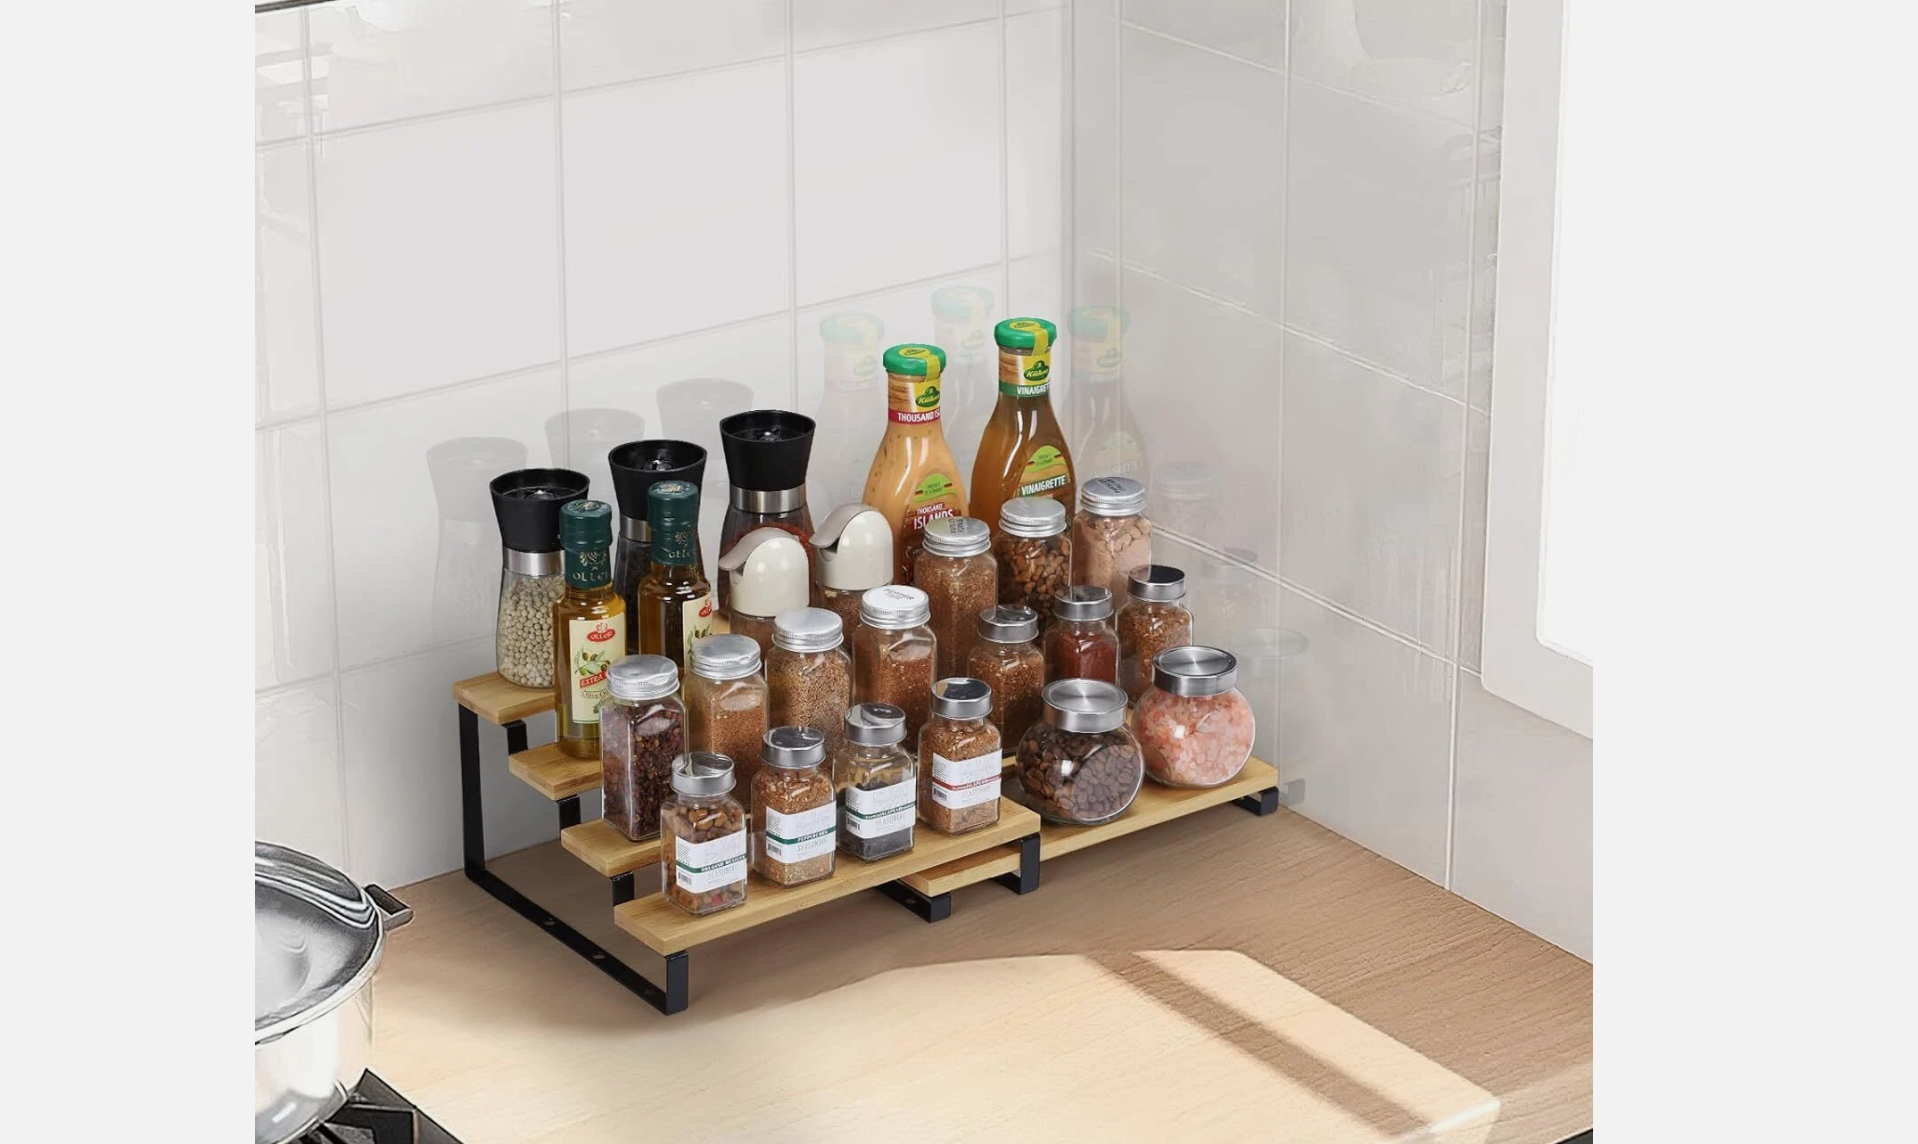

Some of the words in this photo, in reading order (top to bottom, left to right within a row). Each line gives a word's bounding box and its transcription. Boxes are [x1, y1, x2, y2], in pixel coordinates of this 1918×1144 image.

[898, 412, 933, 422] THOUSAND
[1021, 474, 1066, 496] VINAIGRETTE
[917, 503, 943, 515] THOUSAND
[581, 675, 603, 687] EXTRA
